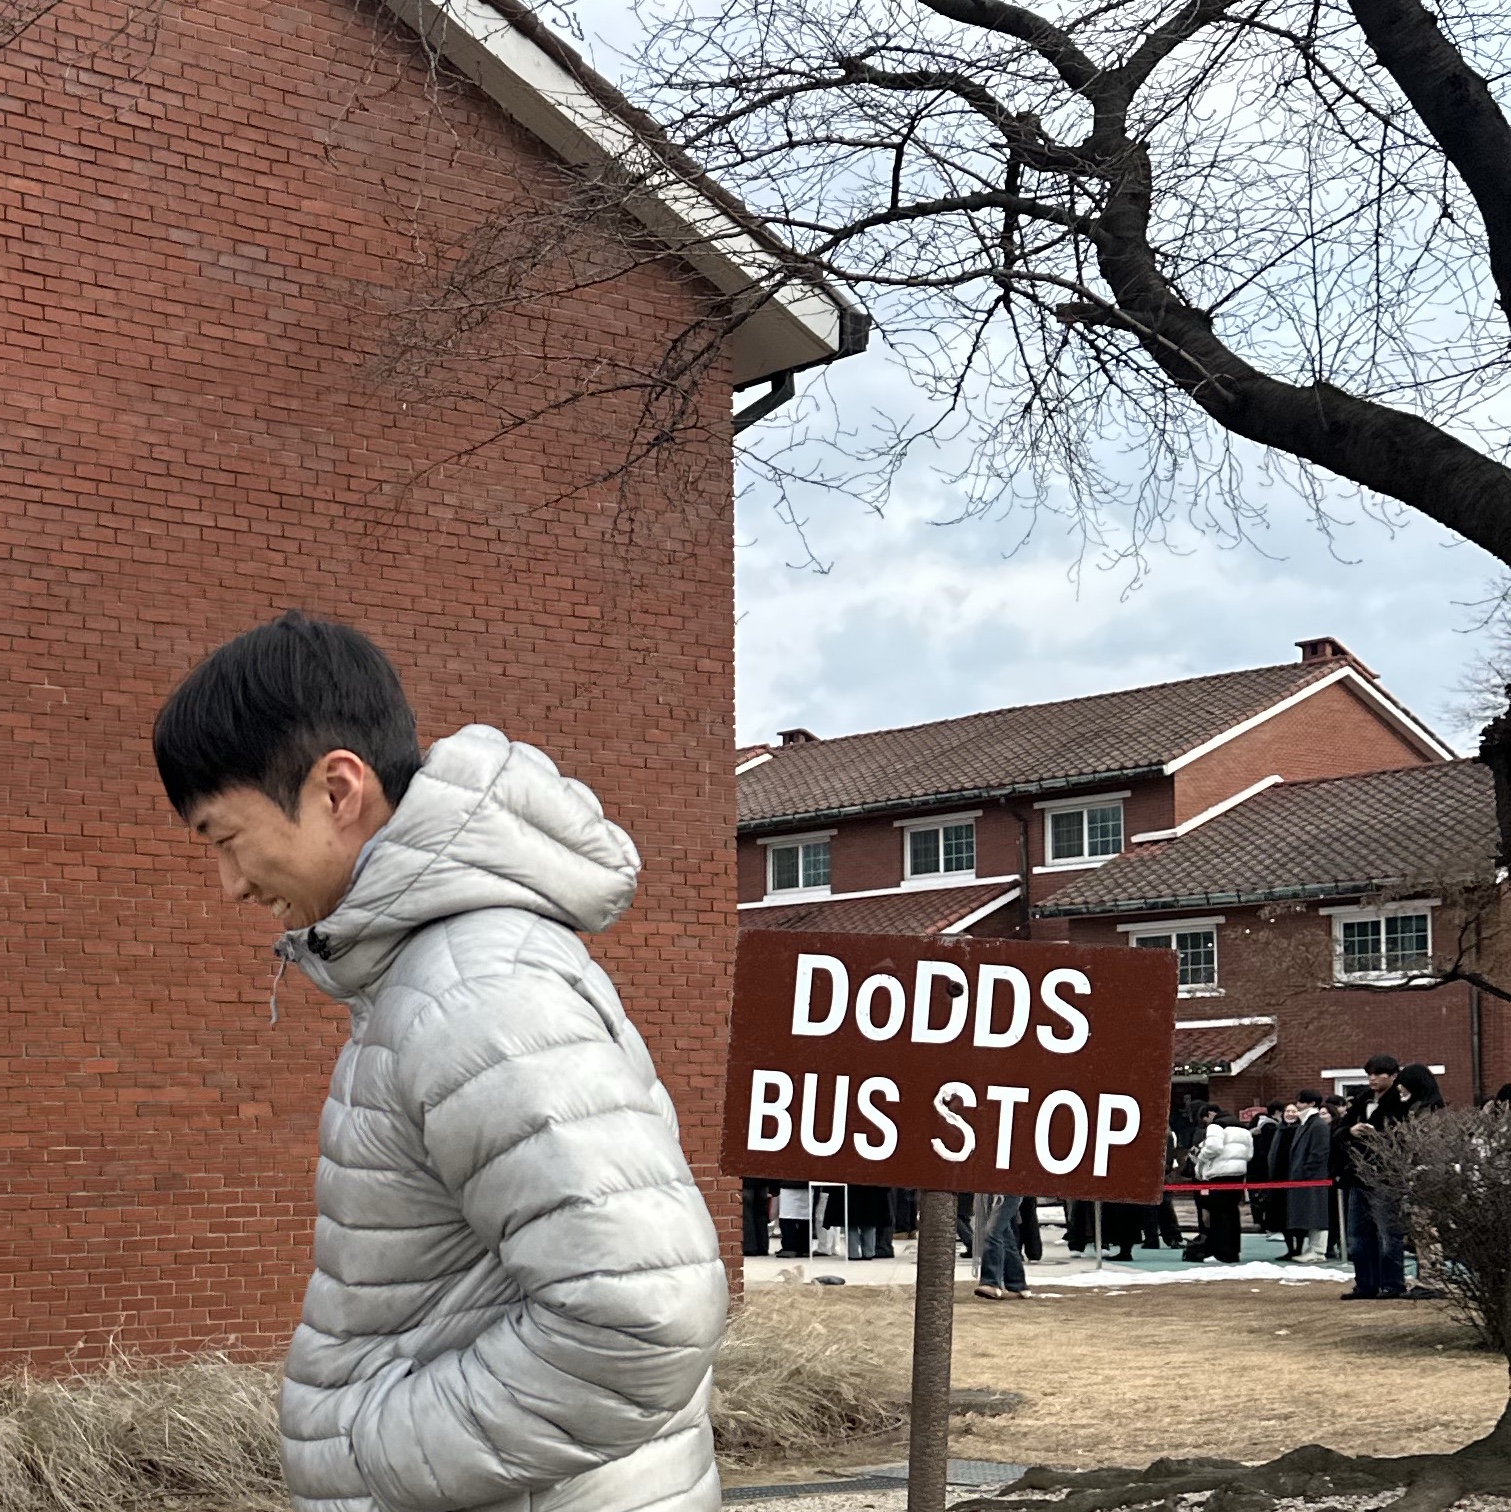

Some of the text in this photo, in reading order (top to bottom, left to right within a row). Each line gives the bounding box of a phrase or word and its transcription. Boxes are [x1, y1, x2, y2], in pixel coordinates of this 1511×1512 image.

[791, 953, 1091, 1054] DoDDS
[747, 1069, 1141, 1177] BUS STOP
